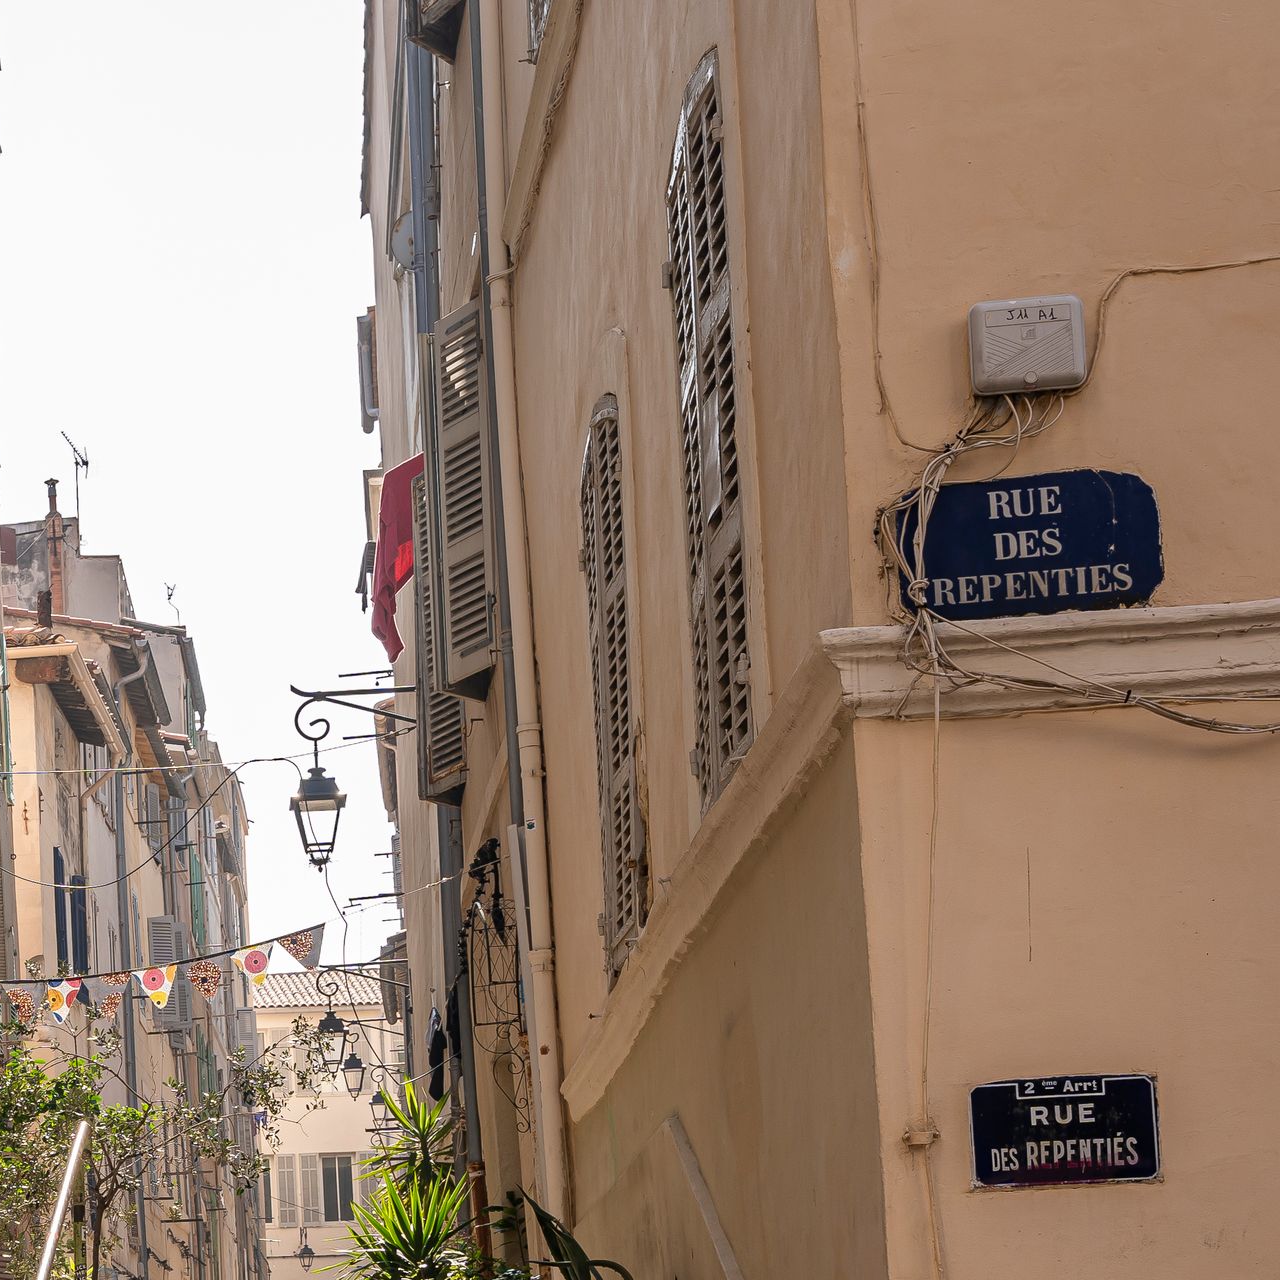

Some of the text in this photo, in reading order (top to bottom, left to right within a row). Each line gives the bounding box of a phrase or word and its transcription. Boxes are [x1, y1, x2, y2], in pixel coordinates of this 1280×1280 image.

[987, 486, 1062, 520] RUE
[993, 527, 1062, 561] DES
[933, 563, 1133, 606] REPENTIES
[1030, 1103, 1096, 1126] RUE
[991, 1148, 1019, 1172] DES
